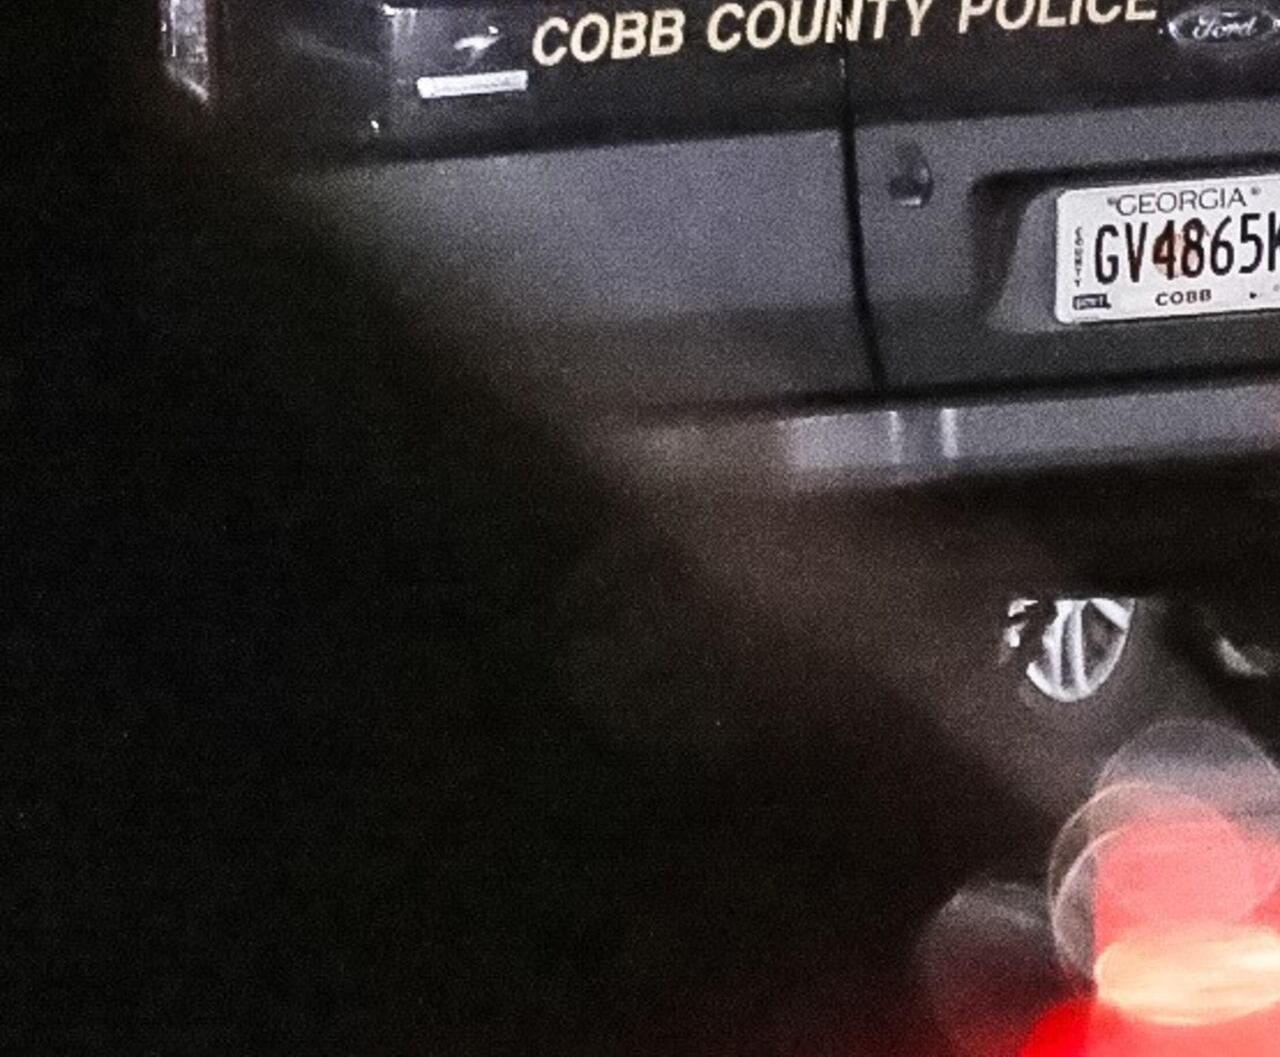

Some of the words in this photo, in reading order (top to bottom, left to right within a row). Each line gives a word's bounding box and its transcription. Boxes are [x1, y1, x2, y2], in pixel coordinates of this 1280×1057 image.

[532, 7, 687, 68] COBB
[1191, 12, 1259, 41] Ford
[1116, 187, 1248, 216] GEORGIA
[1155, 289, 1213, 306] COBB
